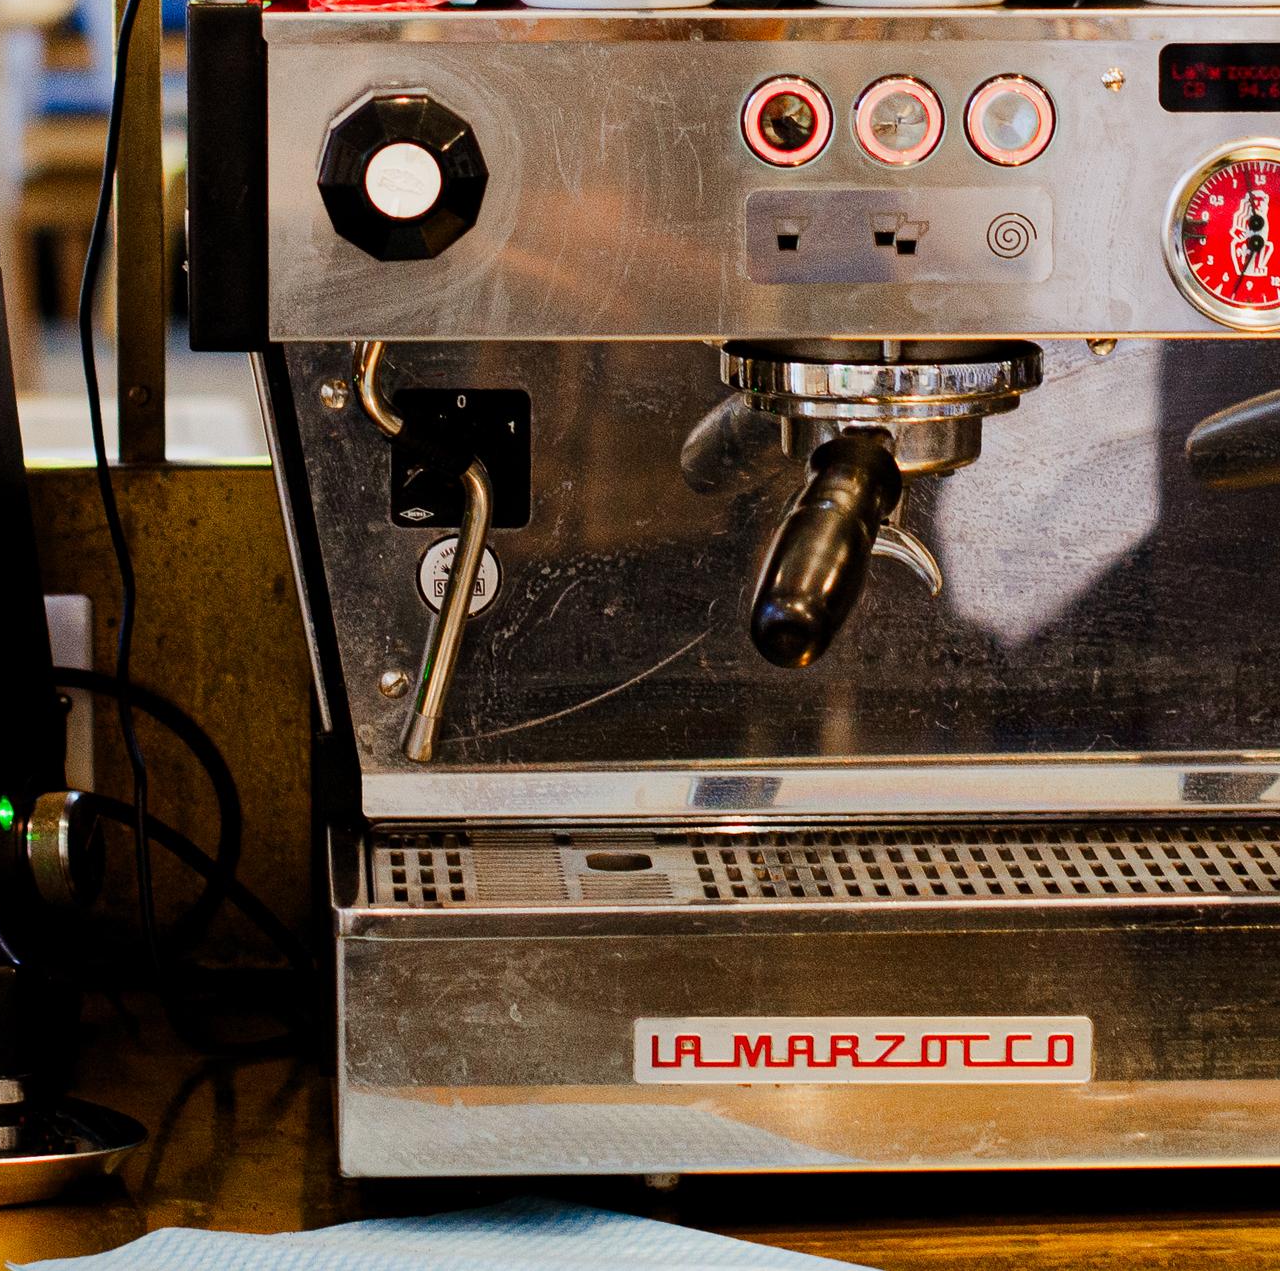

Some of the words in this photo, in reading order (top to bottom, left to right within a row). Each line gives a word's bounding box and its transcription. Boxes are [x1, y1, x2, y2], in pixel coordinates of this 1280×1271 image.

[1206, 254, 1214, 266] 3
[1221, 271, 1230, 282] 6
[1270, 276, 1280, 288] 12
[1245, 280, 1254, 291] 9
[456, 394, 467, 409] 0
[651, 1034, 702, 1069] LA
[733, 1034, 1076, 1069] MARZOCCO
